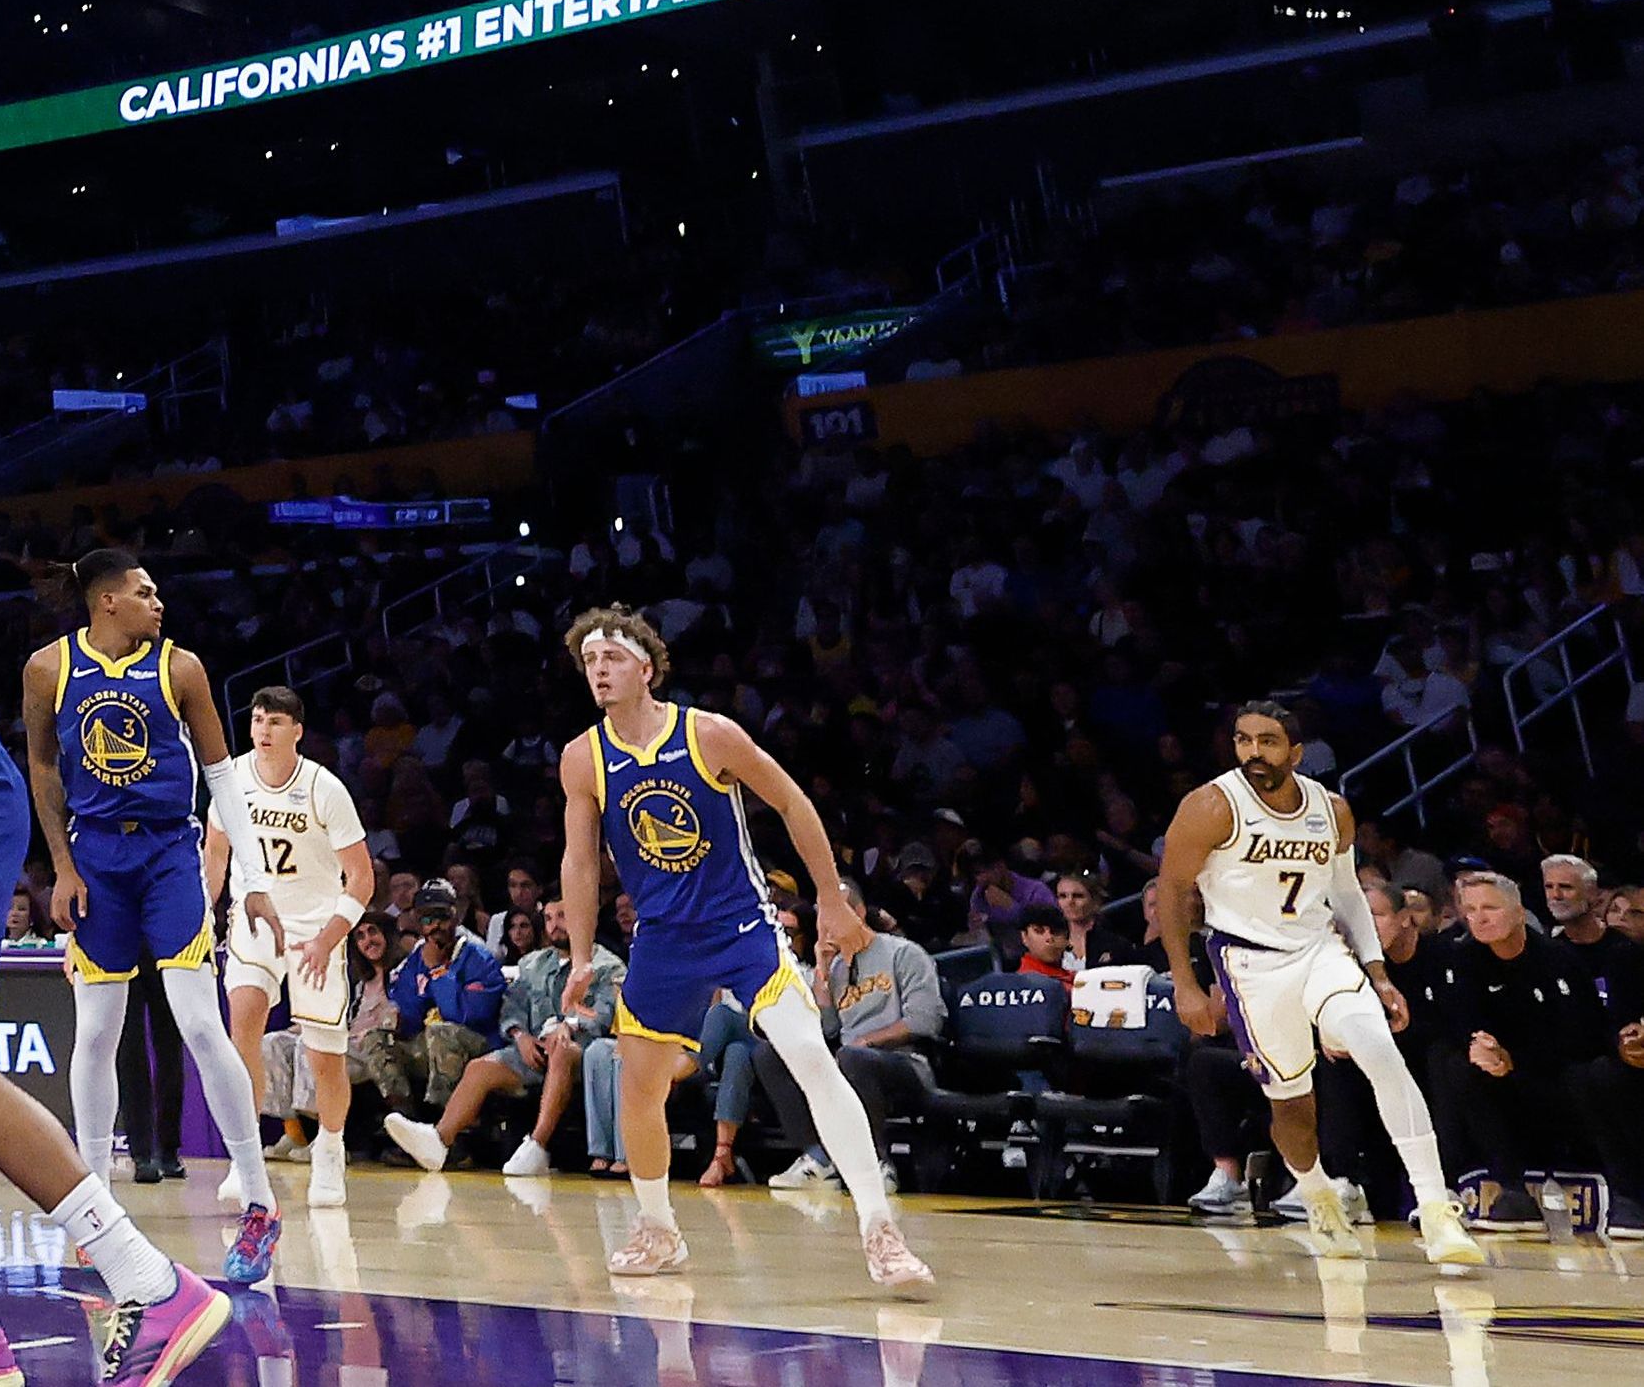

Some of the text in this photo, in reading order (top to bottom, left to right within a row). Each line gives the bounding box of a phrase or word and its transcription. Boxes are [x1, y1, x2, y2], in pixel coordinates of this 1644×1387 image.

[119, 29, 406, 123] CALIFORNIA'S
[416, 17, 464, 61] #1
[76, 690, 151, 717] GOLDEN STATE
[123, 718, 135, 739] 3
[81, 755, 157, 787] WARRIORS
[248, 802, 308, 833] AKERS
[670, 804, 687, 826] 2
[258, 837, 297, 874] 12
[1240, 833, 1330, 865] LAKERS
[1279, 871, 1305, 915] 7
[978, 989, 1046, 1006] DELTA
